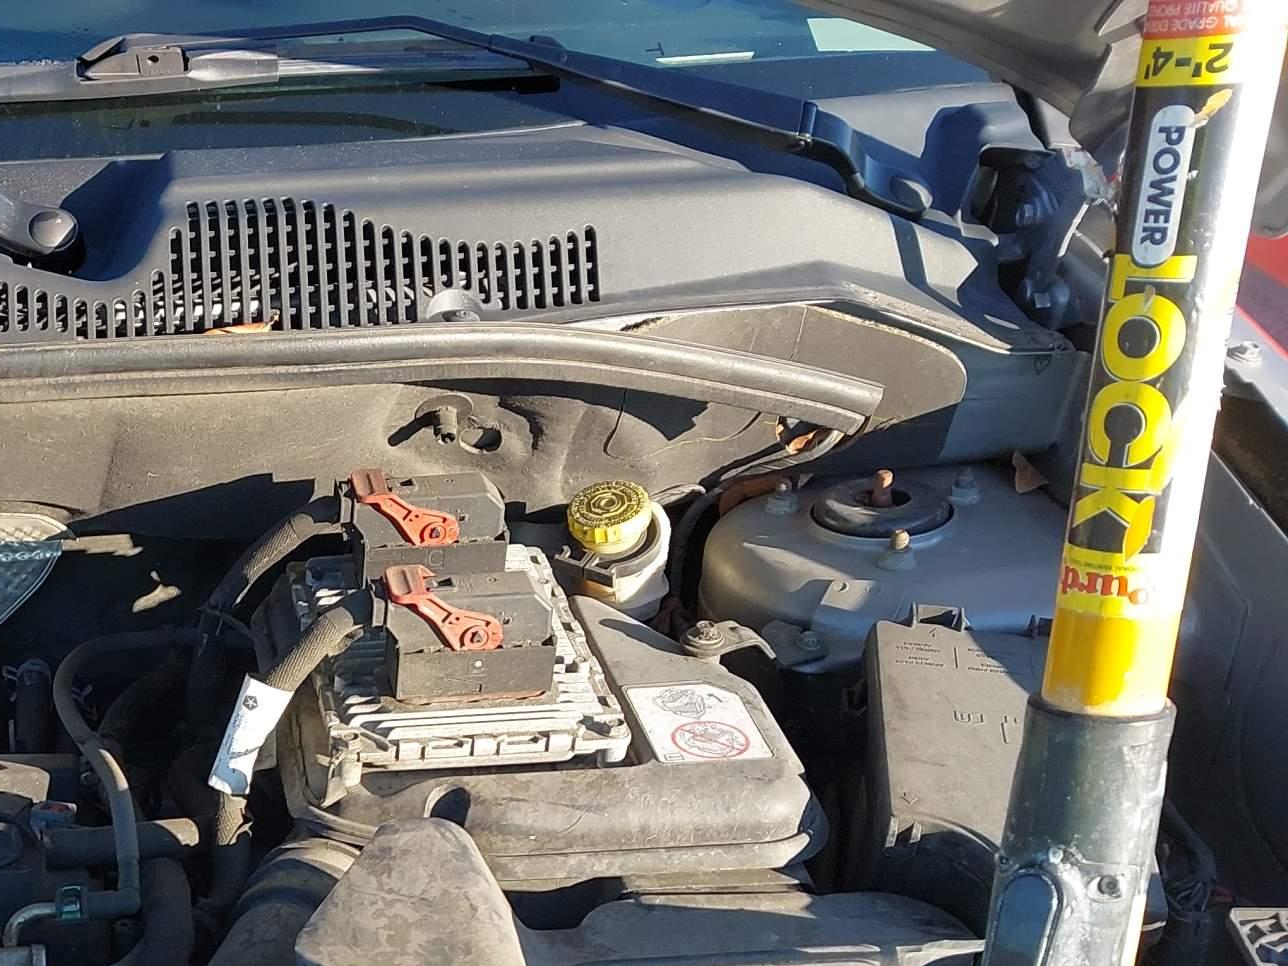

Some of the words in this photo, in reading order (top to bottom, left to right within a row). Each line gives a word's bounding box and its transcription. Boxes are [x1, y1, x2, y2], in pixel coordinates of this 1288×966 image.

[1172, 16, 1218, 31] GRADE
[1140, 125, 1187, 247] POWER
[1072, 254, 1198, 556] LOCK
